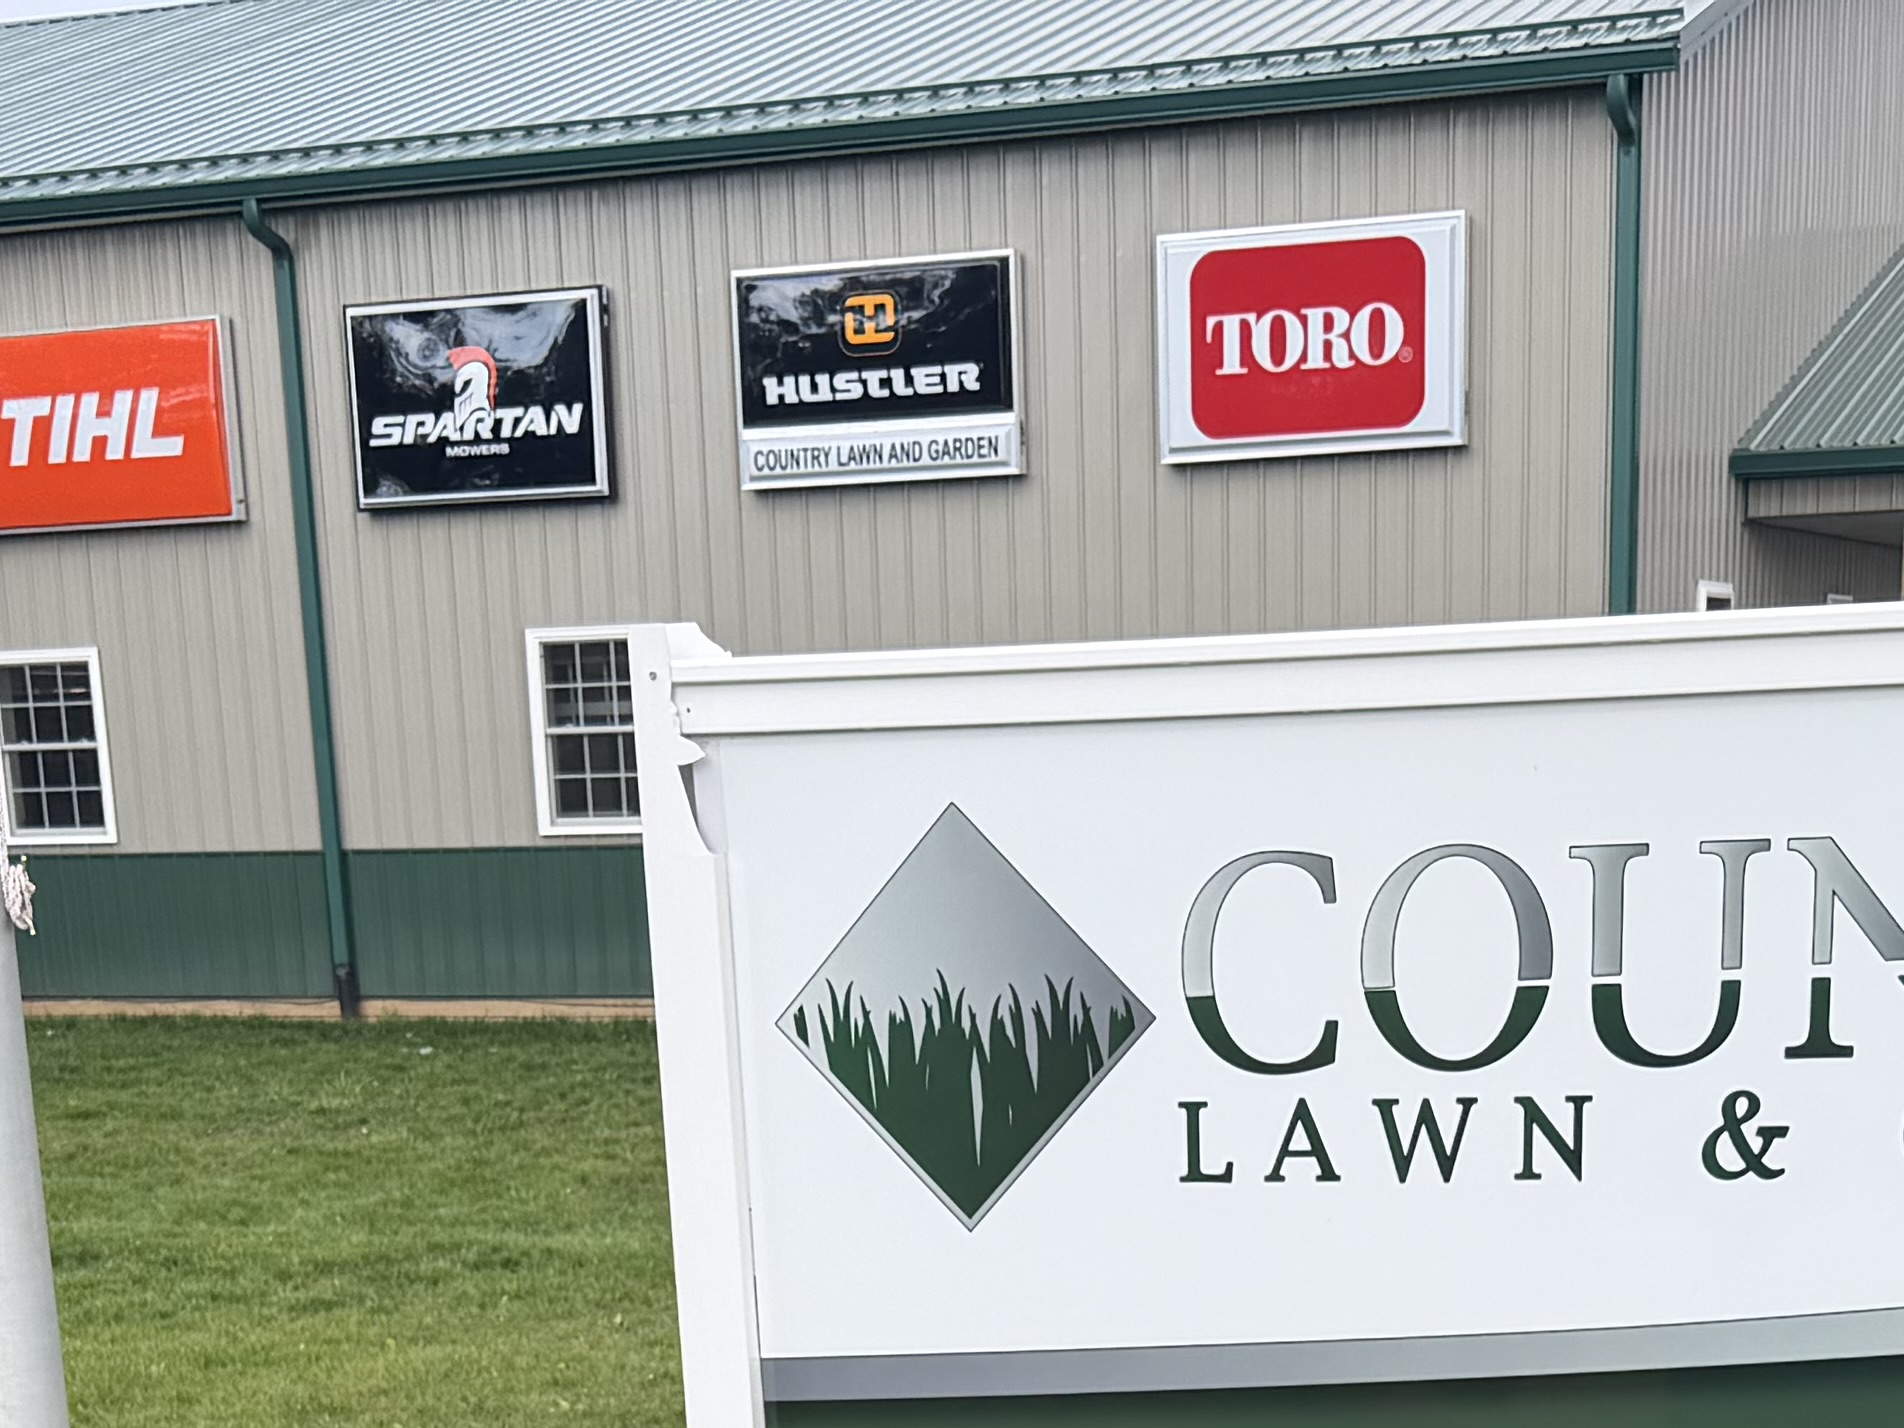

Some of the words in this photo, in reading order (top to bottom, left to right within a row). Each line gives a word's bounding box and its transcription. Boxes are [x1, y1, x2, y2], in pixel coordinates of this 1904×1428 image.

[1205, 301, 1405, 376] TORO
[761, 361, 981, 406] HUSTLER
[368, 402, 584, 448] SPARTAN
[445, 442, 511, 459] MOWERS
[753, 446, 833, 473] COUNTRY
[836, 442, 884, 468] LAWN
[887, 439, 923, 464] AND
[927, 435, 1000, 462] GARDEN
[1177, 1094, 1594, 1184] LAWN
[1700, 1089, 1790, 1181] &
